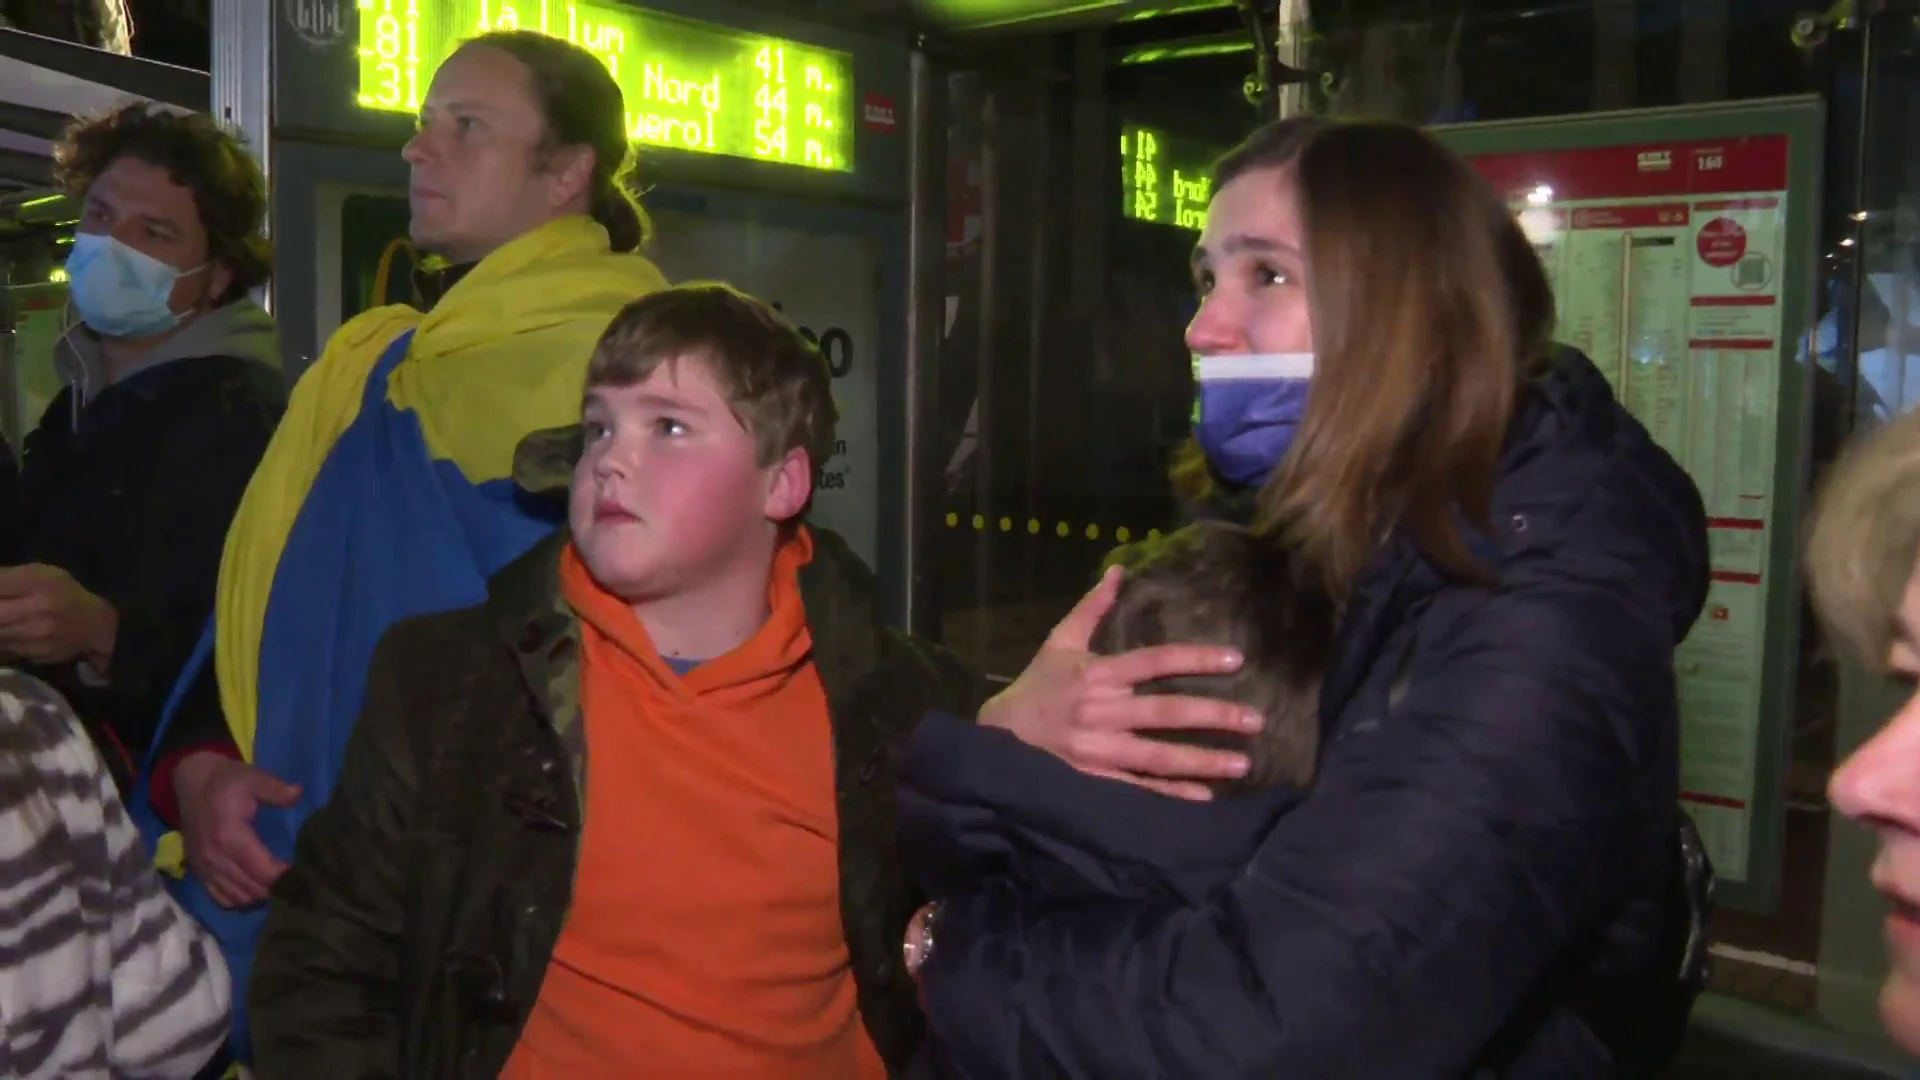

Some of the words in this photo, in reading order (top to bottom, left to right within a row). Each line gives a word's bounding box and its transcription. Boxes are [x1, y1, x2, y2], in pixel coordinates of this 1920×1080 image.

[755, 45, 786, 83] 41
[805, 65, 833, 90] m.
[643, 62, 721, 112] Nord
[755, 83, 789, 122] 44
[805, 102, 833, 127] m.
[624, 110, 717, 148] uerol
[755, 118, 788, 158] 54
[805, 140, 833, 165] m.
[818, 466, 846, 491] tes
